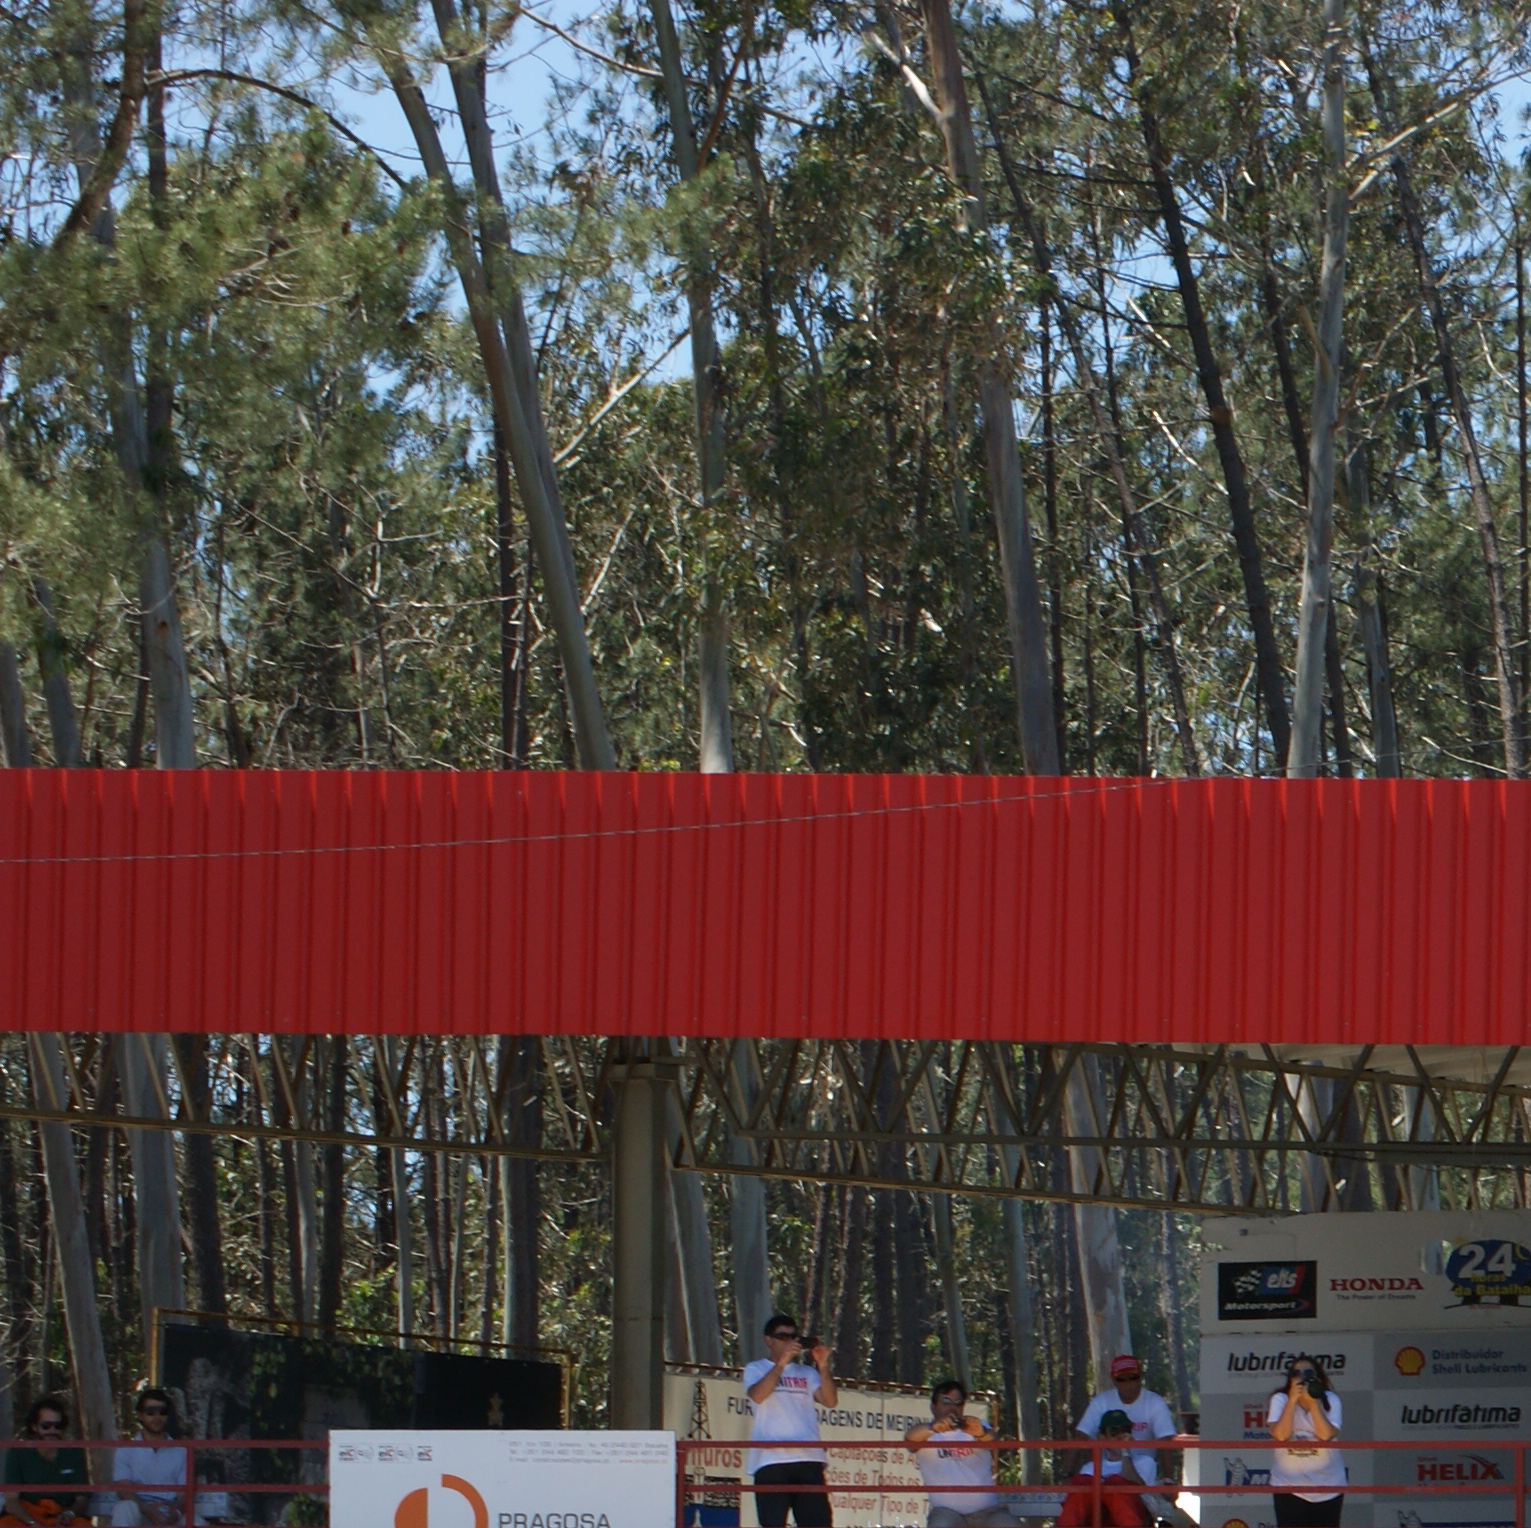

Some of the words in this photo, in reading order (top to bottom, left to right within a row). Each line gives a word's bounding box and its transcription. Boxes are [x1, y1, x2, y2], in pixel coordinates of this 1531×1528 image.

[1458, 1242, 1516, 1279] 24
[1329, 1278, 1425, 1292] HONDA
[1432, 1348, 1504, 1361] Distribuidor
[1432, 1362, 1462, 1374] Shell
[866, 1412, 883, 1430] DE
[1418, 1463, 1500, 1481] HELIX
[880, 1495, 903, 1515] Tipo
